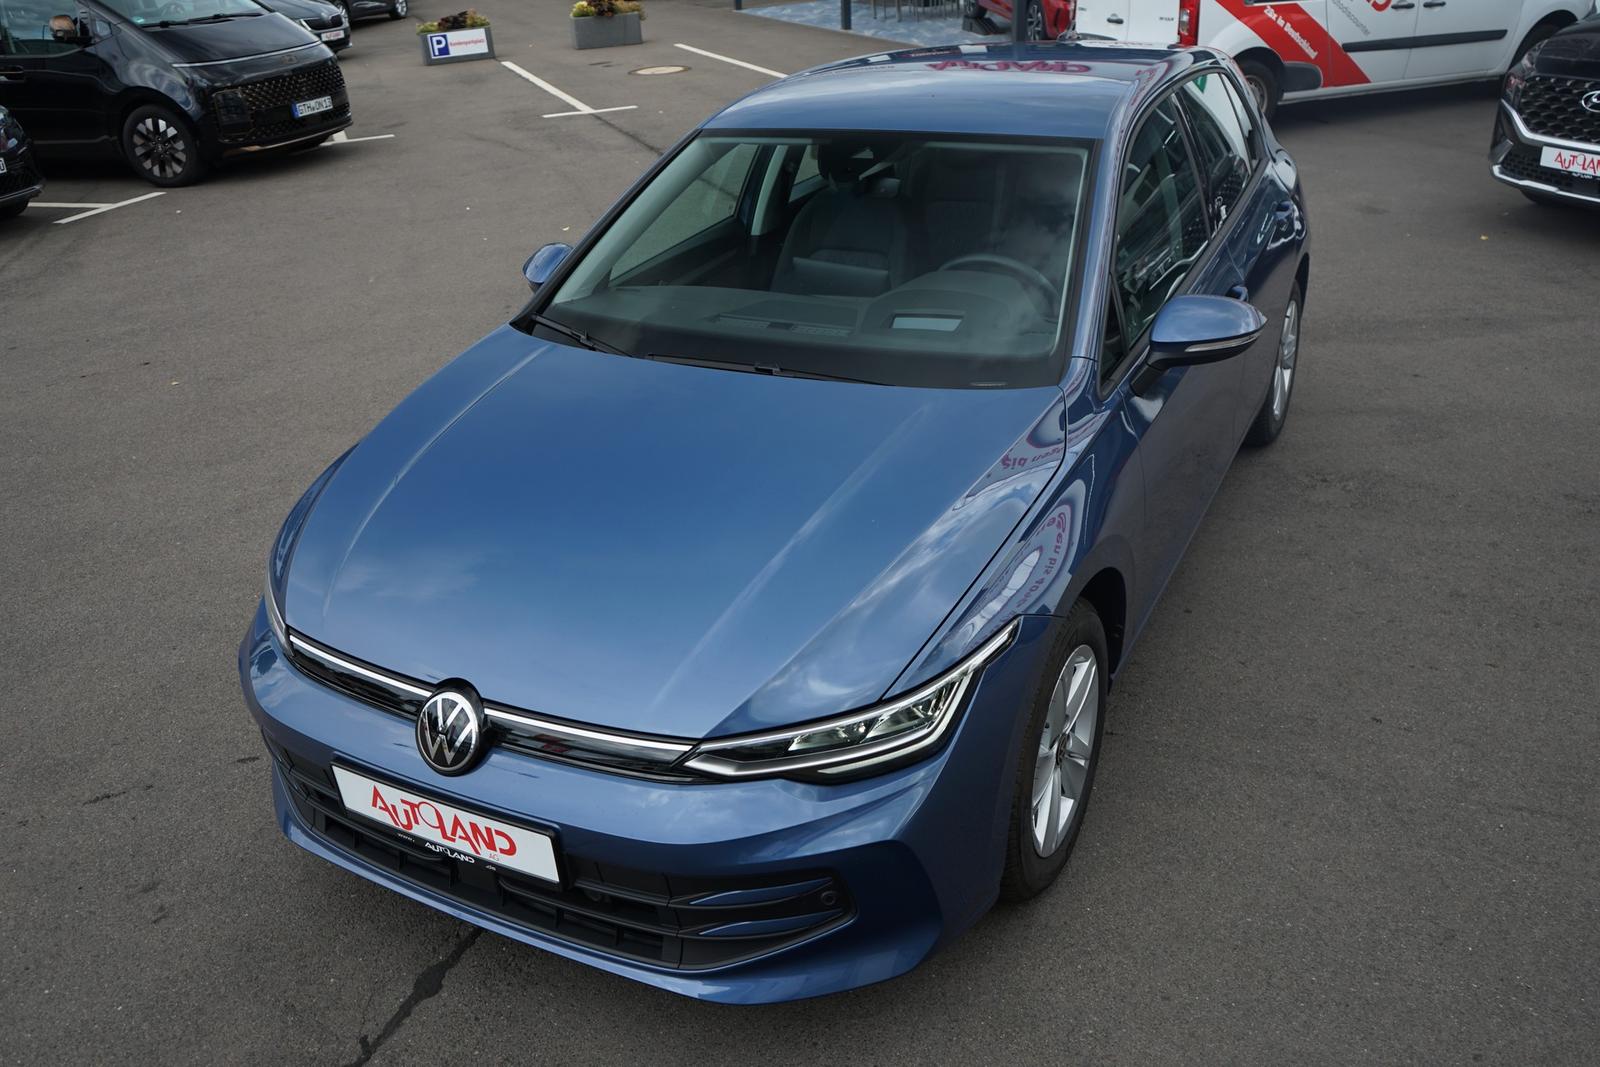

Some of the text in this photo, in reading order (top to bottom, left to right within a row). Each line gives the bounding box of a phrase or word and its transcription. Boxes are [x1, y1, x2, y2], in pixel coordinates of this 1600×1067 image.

[432, 36, 446, 56] P
[371, 785, 517, 857] AUTOLAND
[425, 842, 475, 864] AUTOLAND
